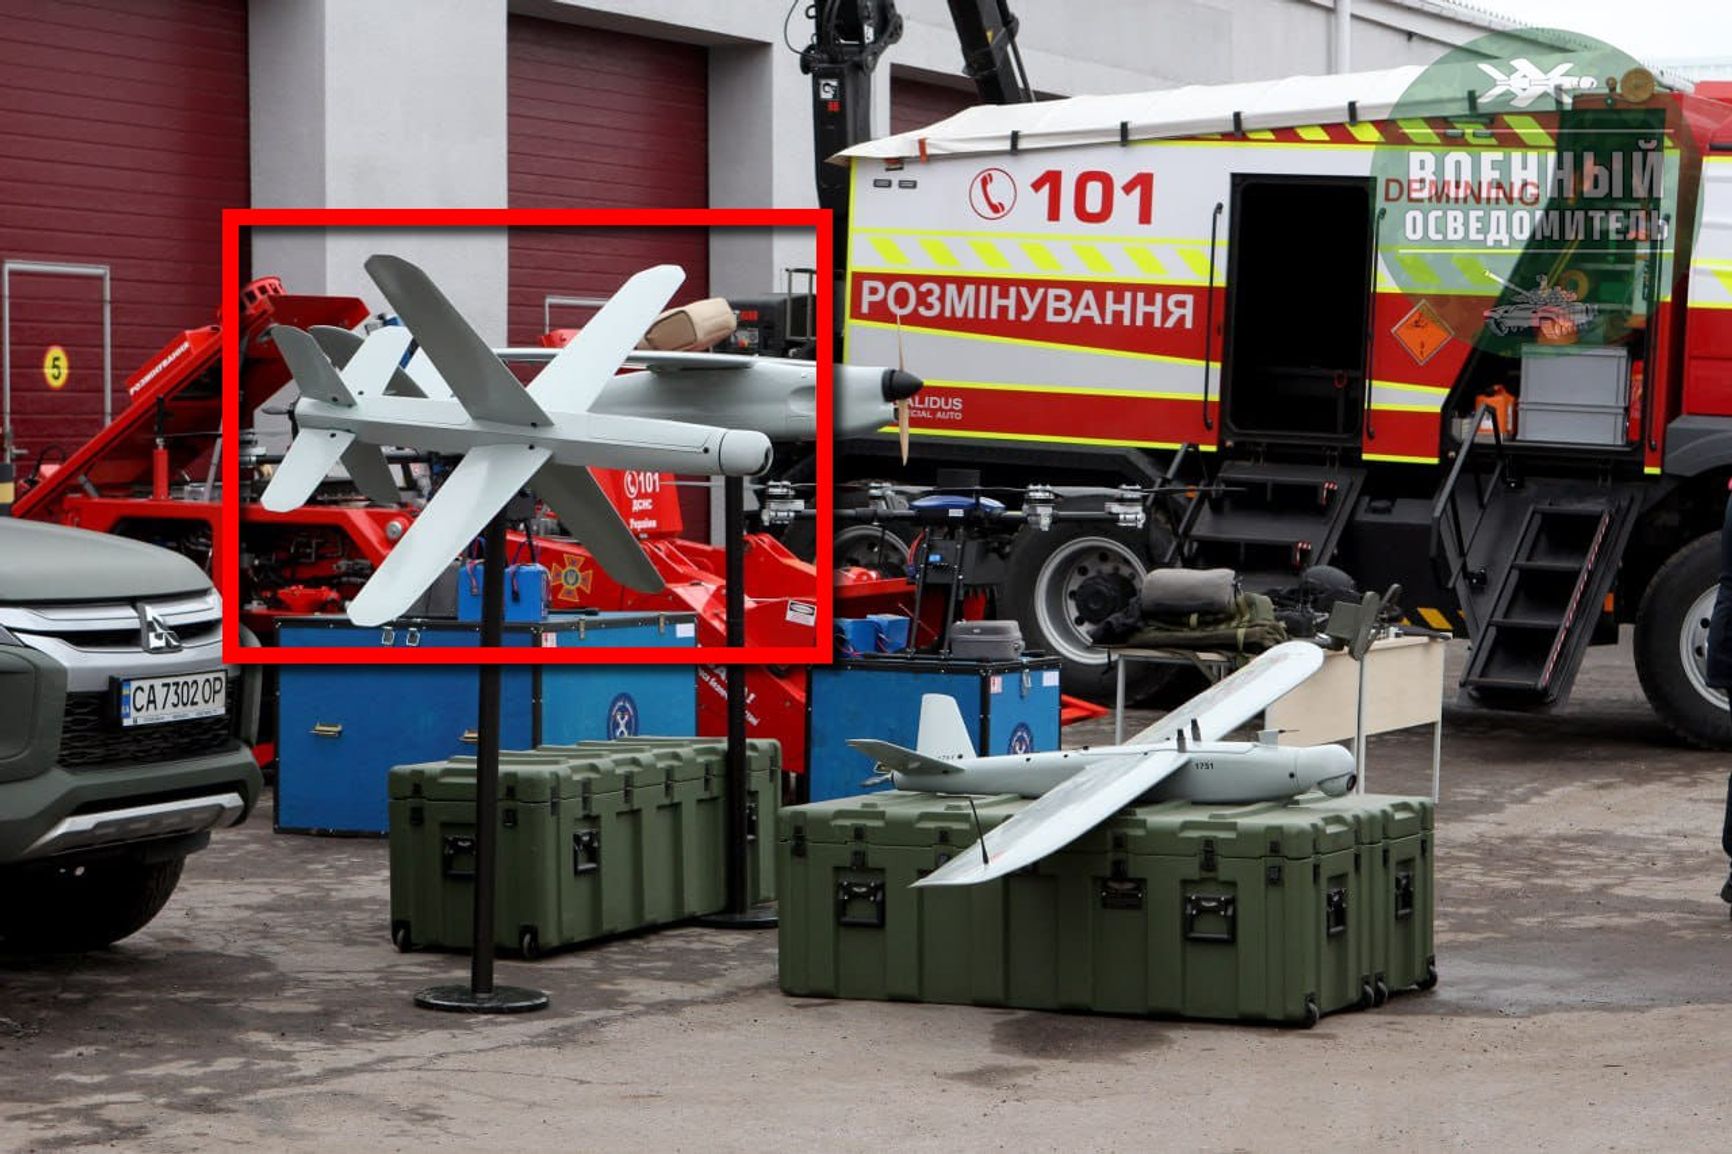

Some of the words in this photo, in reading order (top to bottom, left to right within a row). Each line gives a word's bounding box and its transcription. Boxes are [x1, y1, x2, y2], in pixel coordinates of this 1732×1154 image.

[1030, 170, 1154, 225] 101
[1384, 178, 1541, 206] DEMINING
[860, 281, 1194, 329] РОЗМІНУВАННЯ
[52, 356, 61, 380] 5
[936, 410, 962, 420] AUTO
[639, 472, 660, 493] 101
[132, 684, 157, 712] CA
[161, 680, 199, 710] 7302
[202, 676, 223, 704] OP
